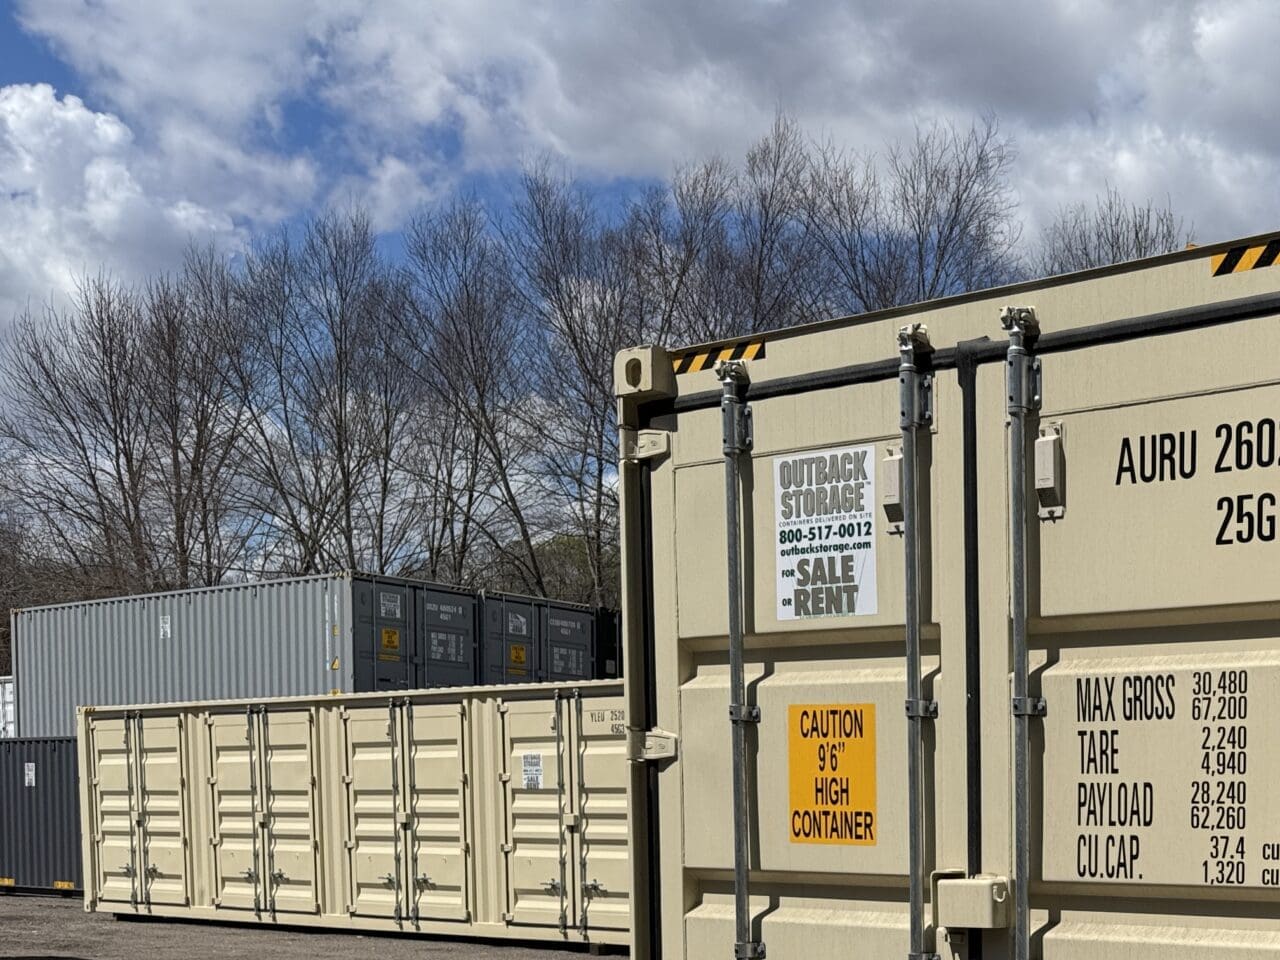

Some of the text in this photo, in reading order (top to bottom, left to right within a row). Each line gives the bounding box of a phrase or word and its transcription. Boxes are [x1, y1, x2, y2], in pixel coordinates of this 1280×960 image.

[779, 450, 868, 489] OUTBACK
[1115, 430, 1197, 485] AURU
[780, 482, 865, 520] STORAGE
[779, 518, 814, 528] CONTAINERS
[814, 514, 847, 524] DELIVERED
[779, 521, 872, 544] 800-517-0012
[780, 541, 871, 557] outbackstorage.com
[781, 555, 855, 587] FOR SALE
[782, 585, 859, 617] OR RENT
[1076, 677, 1116, 722] MAX
[1122, 674, 1176, 721] GROSS
[1192, 670, 1248, 696] 30,480
[1192, 696, 1248, 722] 67,200
[610, 710, 624, 721] 2520
[800, 709, 863, 738] CAUTION
[1077, 730, 1119, 775] TARE
[1201, 725, 1247, 751] 2,240
[1201, 751, 1247, 777] 4,940
[815, 777, 850, 806] HIGH
[1077, 782, 1154, 827] PAYLOAD
[1191, 781, 1247, 806] 28,240
[791, 810, 874, 840] CONTAINER
[1190, 806, 1246, 831] 62,260
[1077, 834, 1144, 880] CU.CAP.
[1209, 835, 1246, 860] 37.4
[1202, 861, 1245, 885] 1,320
